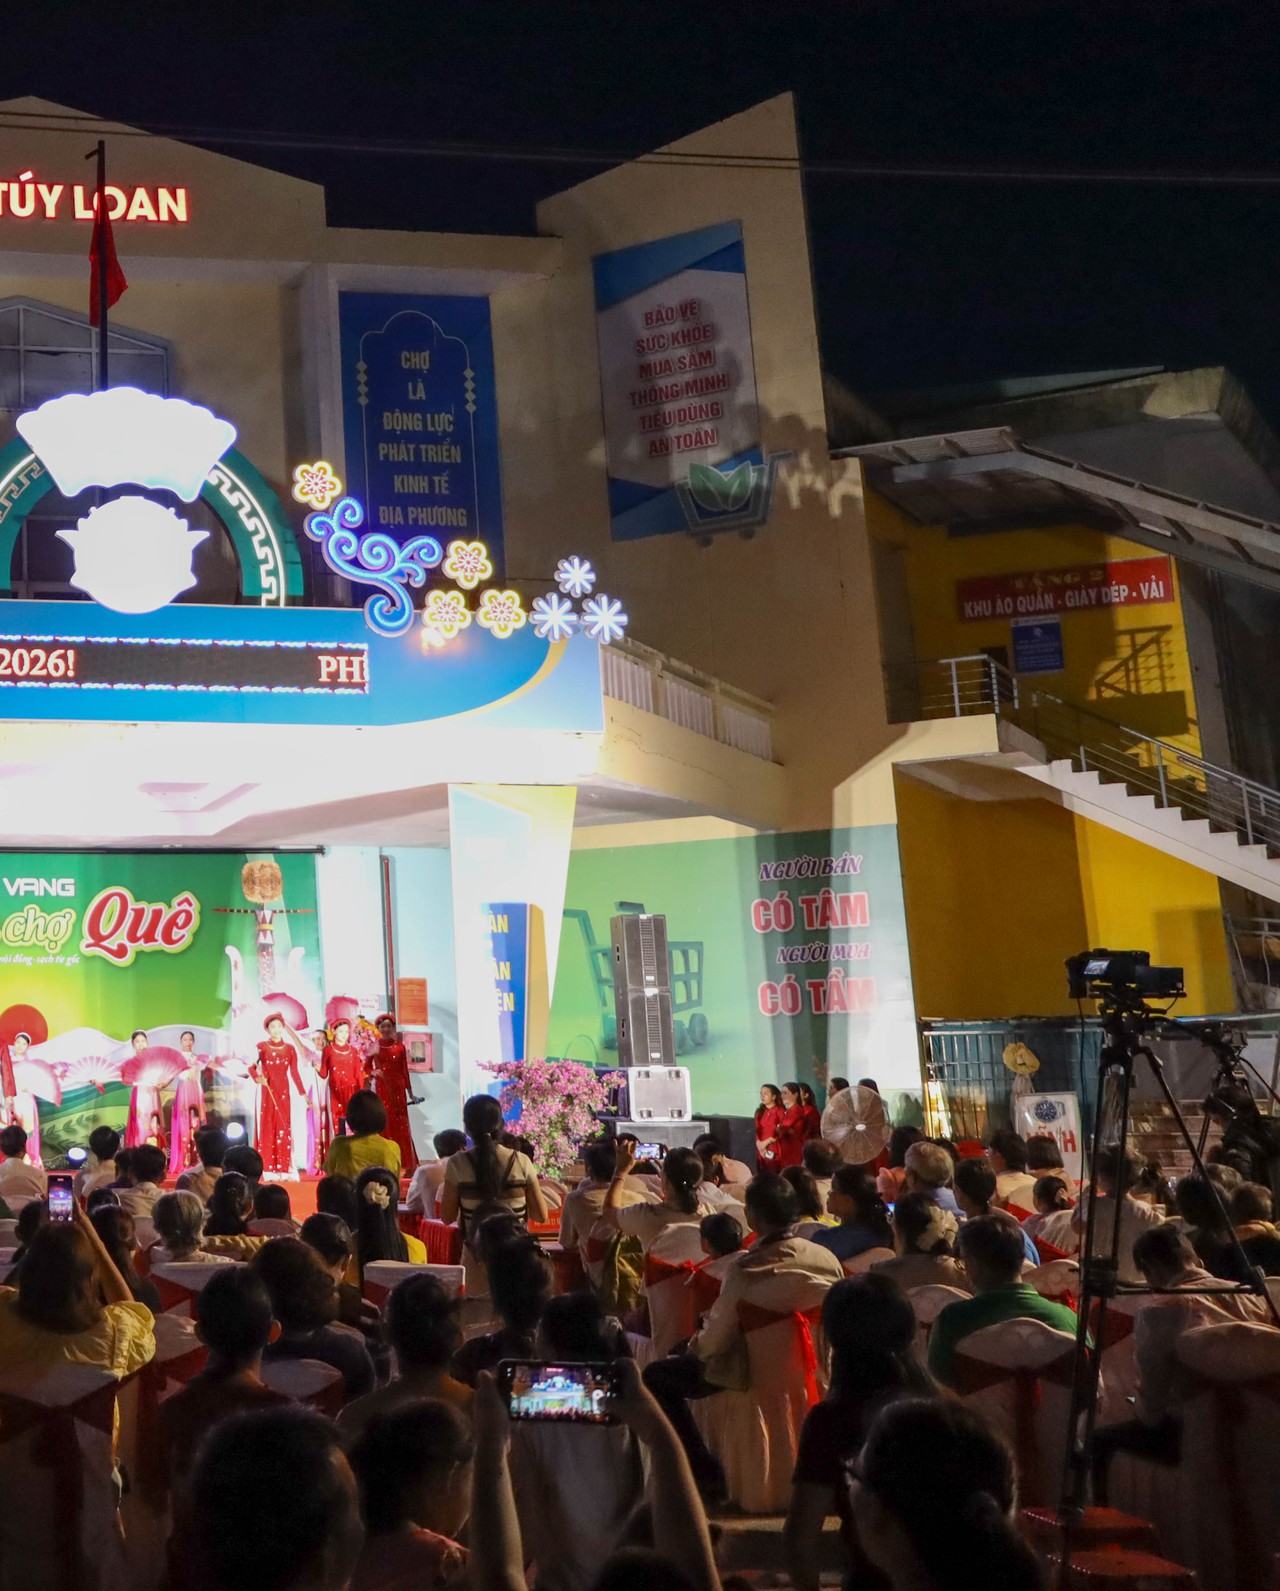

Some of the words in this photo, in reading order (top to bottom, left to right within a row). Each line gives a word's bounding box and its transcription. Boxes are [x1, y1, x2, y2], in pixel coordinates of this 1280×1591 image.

[73, 184, 188, 222] LOAN
[644, 303, 675, 326] BẢO
[636, 332, 666, 355] SỨC
[400, 350, 430, 374] CHỢ
[639, 359, 673, 379] MUA
[677, 347, 713, 372] SẮM
[407, 378, 426, 401] LÀ
[630, 382, 680, 407] THÔNG
[684, 373, 727, 396] MINH
[382, 408, 423, 435] ĐỘNG
[426, 410, 455, 436] LỰC
[639, 408, 672, 430] TIÊU
[677, 401, 721, 423] DÙNG
[378, 440, 415, 463] PHÁT
[419, 437, 462, 464] TRIỂN
[648, 438, 670, 456] AN
[674, 427, 716, 450] TOÀN
[393, 473, 429, 494] KINH
[432, 470, 450, 495] TẾ
[378, 505, 405, 529] ĐỊA
[407, 505, 468, 527] PHƯƠNG
[963, 600, 992, 619] KHU
[995, 594, 1014, 616] ÁO
[1016, 587, 1055, 614] QUẦN
[1064, 584, 1099, 609] GIÀY
[1101, 580, 1129, 604] DÉP
[1139, 574, 1165, 600] VẢI
[318, 655, 364, 683] PH
[760, 855, 820, 880] NGƯỜI
[821, 852, 863, 876] BÁN
[2, 876, 76, 897] VANG
[752, 891, 794, 932] CÓ
[799, 887, 870, 929] TÂM
[3, 905, 74, 951] chợ
[83, 888, 196, 962] Quê
[0, 953, 11, 965] nội
[777, 941, 829, 963] NGƯỜI
[831, 942, 871, 960] MUA
[758, 973, 801, 1016] CÓ
[806, 967, 877, 1014] TẦM
